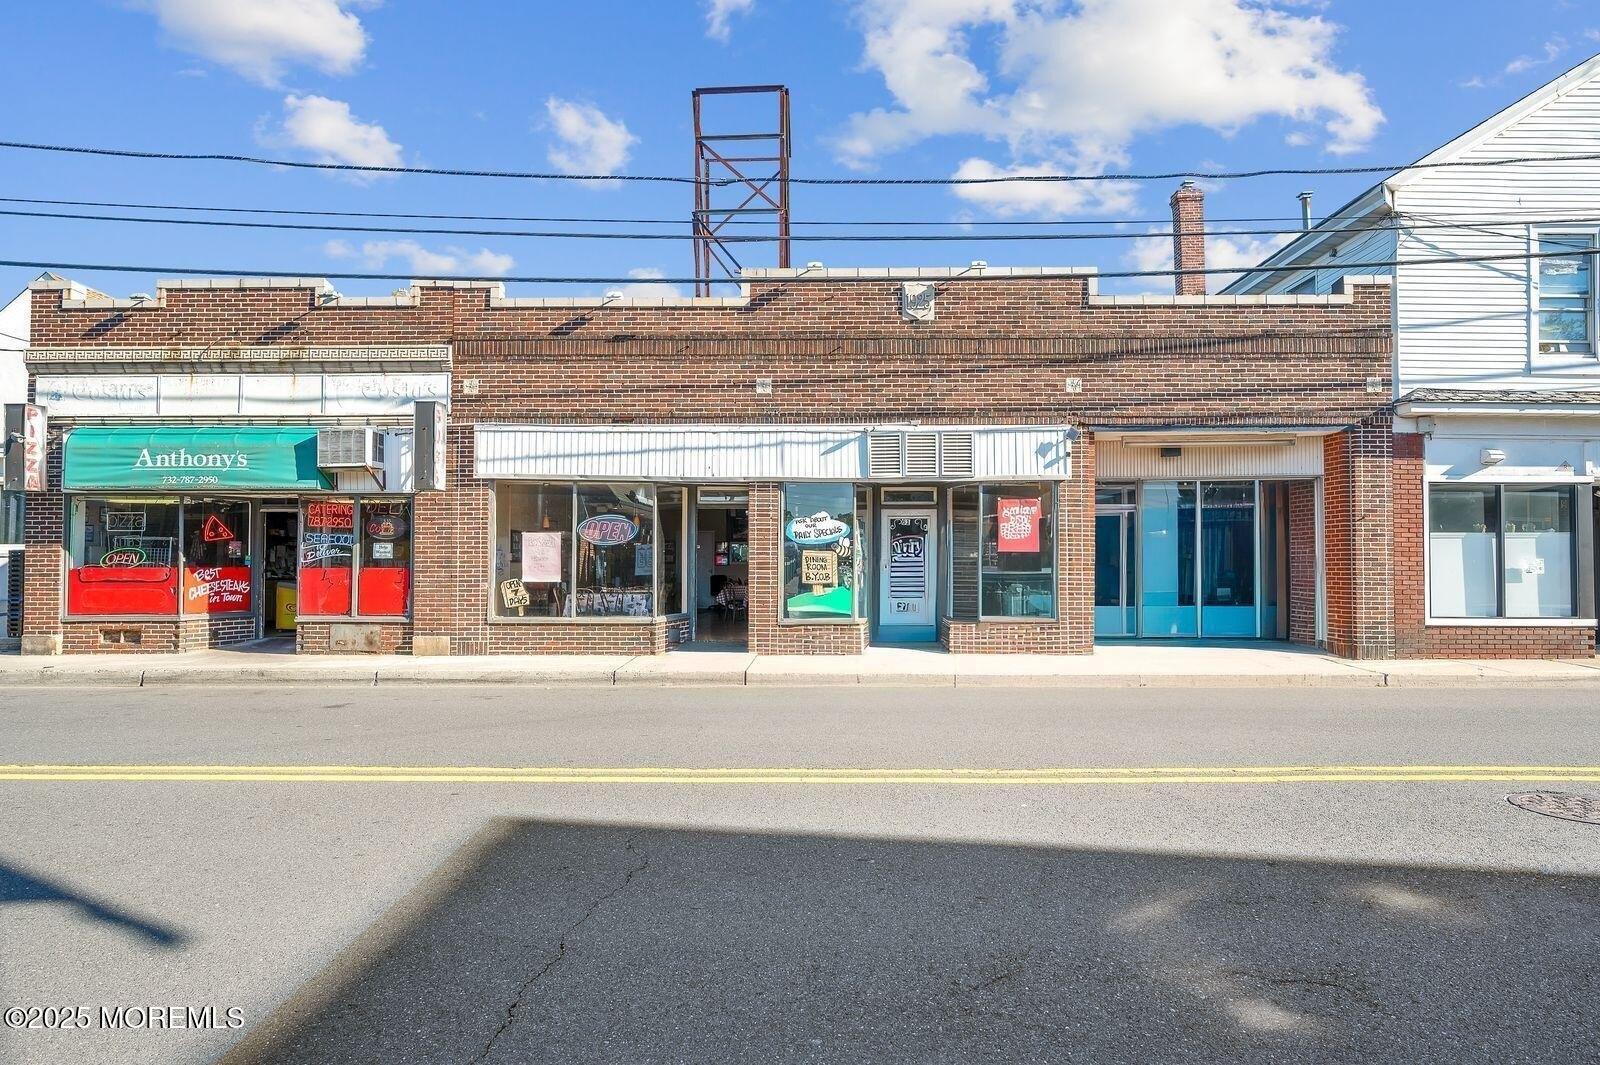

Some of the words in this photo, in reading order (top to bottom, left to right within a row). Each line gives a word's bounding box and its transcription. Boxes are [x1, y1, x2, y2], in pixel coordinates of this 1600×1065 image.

[134, 448, 248, 471] Anthony's
[162, 475, 218, 484] 732-787-2950
[308, 504, 353, 515] CATERING
[584, 520, 632, 540] OPEN
[106, 553, 139, 564] OPEN
[805, 556, 828, 564] DINING
[188, 579, 250, 600] CHEESESTEAKS
